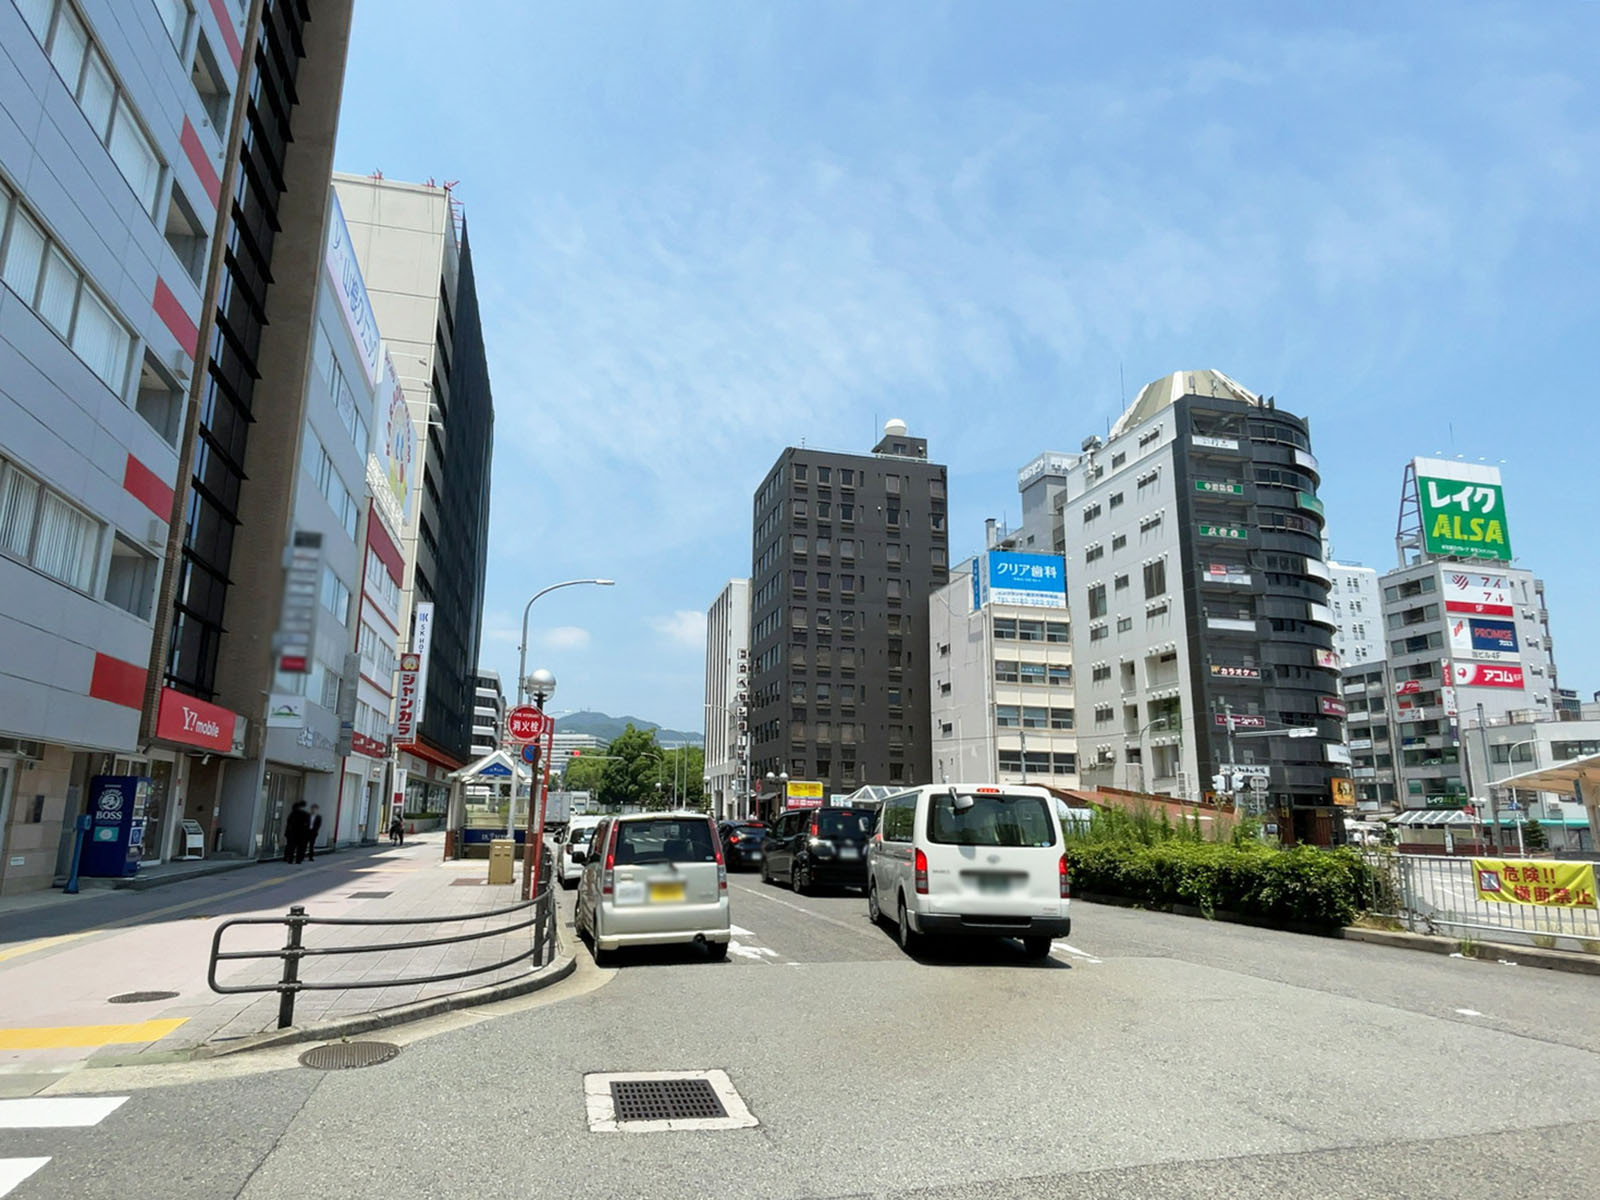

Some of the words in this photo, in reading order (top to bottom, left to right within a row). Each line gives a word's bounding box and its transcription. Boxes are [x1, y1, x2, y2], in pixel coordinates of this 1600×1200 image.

[1428, 481, 1496, 514] レイク
[1431, 514, 1504, 545] ALSA
[997, 562, 1057, 579] クリア歯科
[1474, 627, 1514, 641] PROMISE
[1220, 667, 1250, 677] カラオケ
[1482, 669, 1514, 683] アコム
[397, 673, 416, 736] ジャンカラ
[182, 706, 220, 738] Y!mobile
[512, 719, 540, 732] 消火栓
[96, 810, 123, 820] BOSS
[1502, 865, 1557, 884] 危険!!
[1513, 884, 1594, 906] 横断禁止
